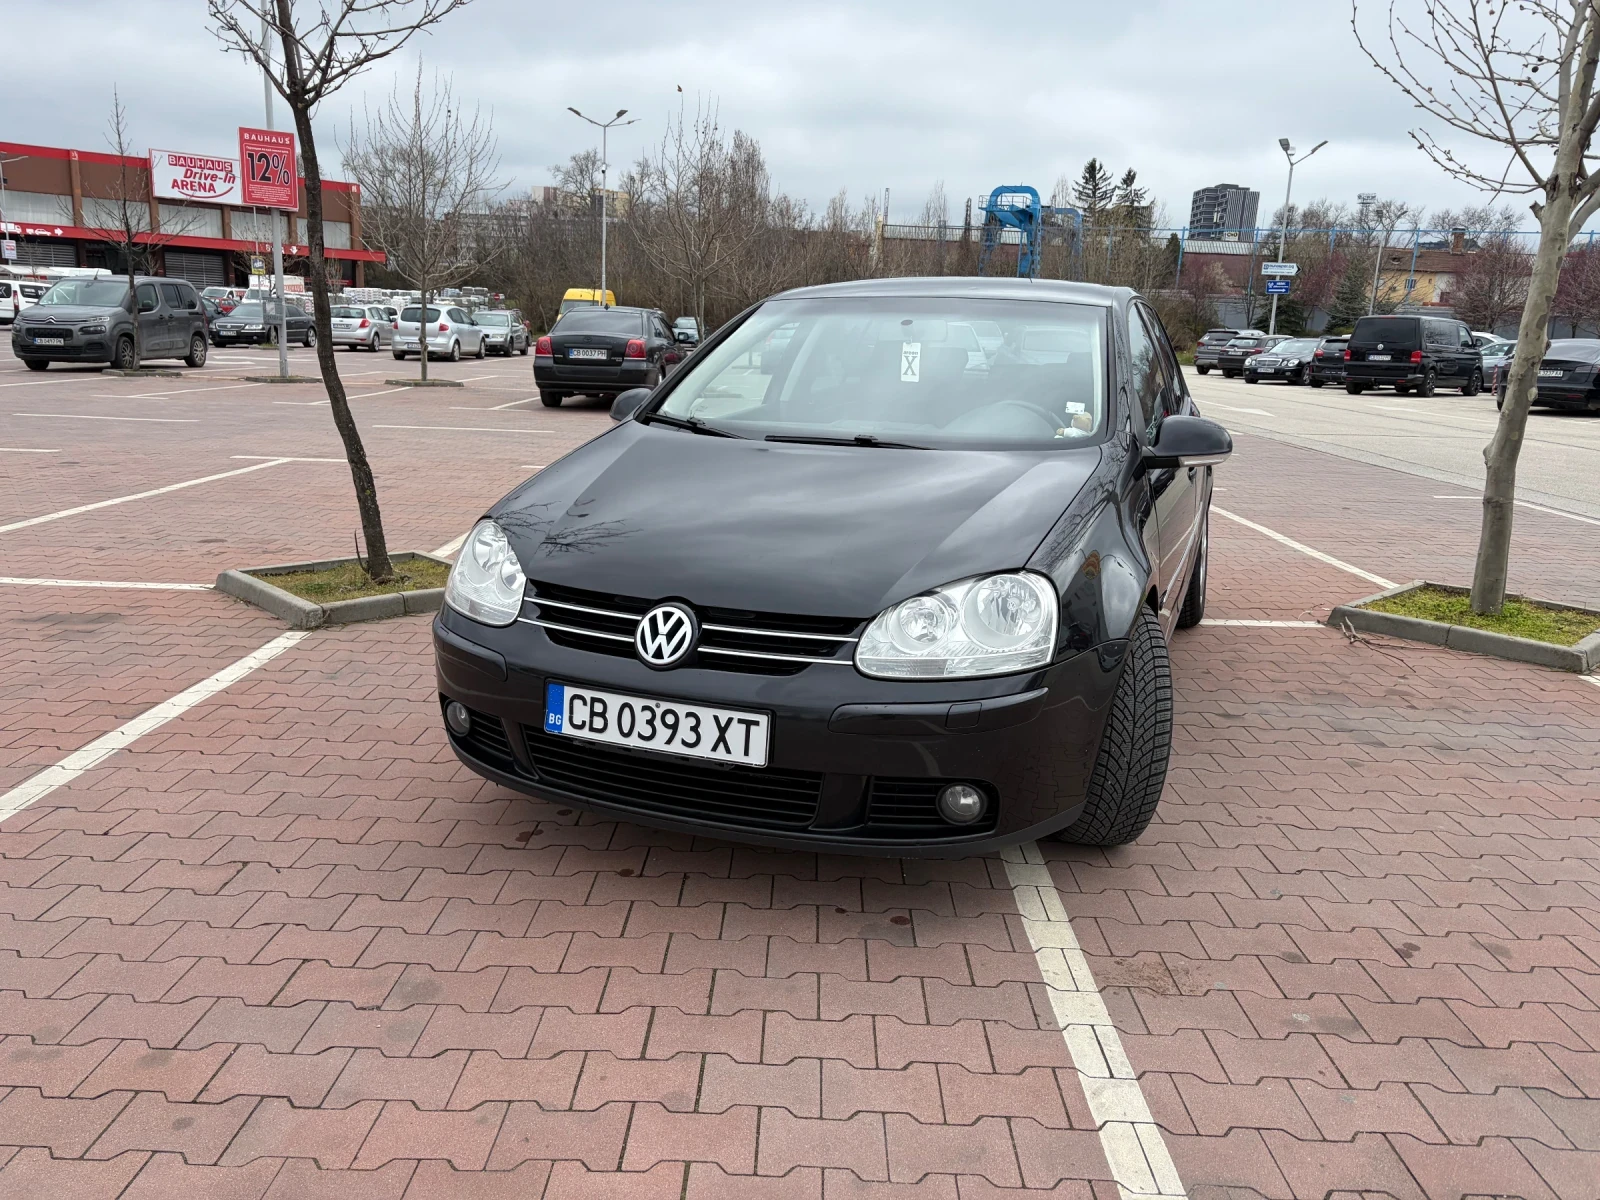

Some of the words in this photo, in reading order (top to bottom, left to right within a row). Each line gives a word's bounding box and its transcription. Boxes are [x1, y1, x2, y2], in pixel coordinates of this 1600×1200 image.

[244, 133, 290, 145] BAUHAUS
[168, 154, 232, 172] BAUHAUS
[247, 152, 290, 185] 12%
[183, 168, 236, 184] Drive-In
[171, 179, 217, 193] ARENA
[902, 355, 918, 376] X
[548, 713, 562, 725] BG
[568, 693, 609, 733] CB
[617, 702, 702, 748] 0393
[710, 714, 760, 757] XT
